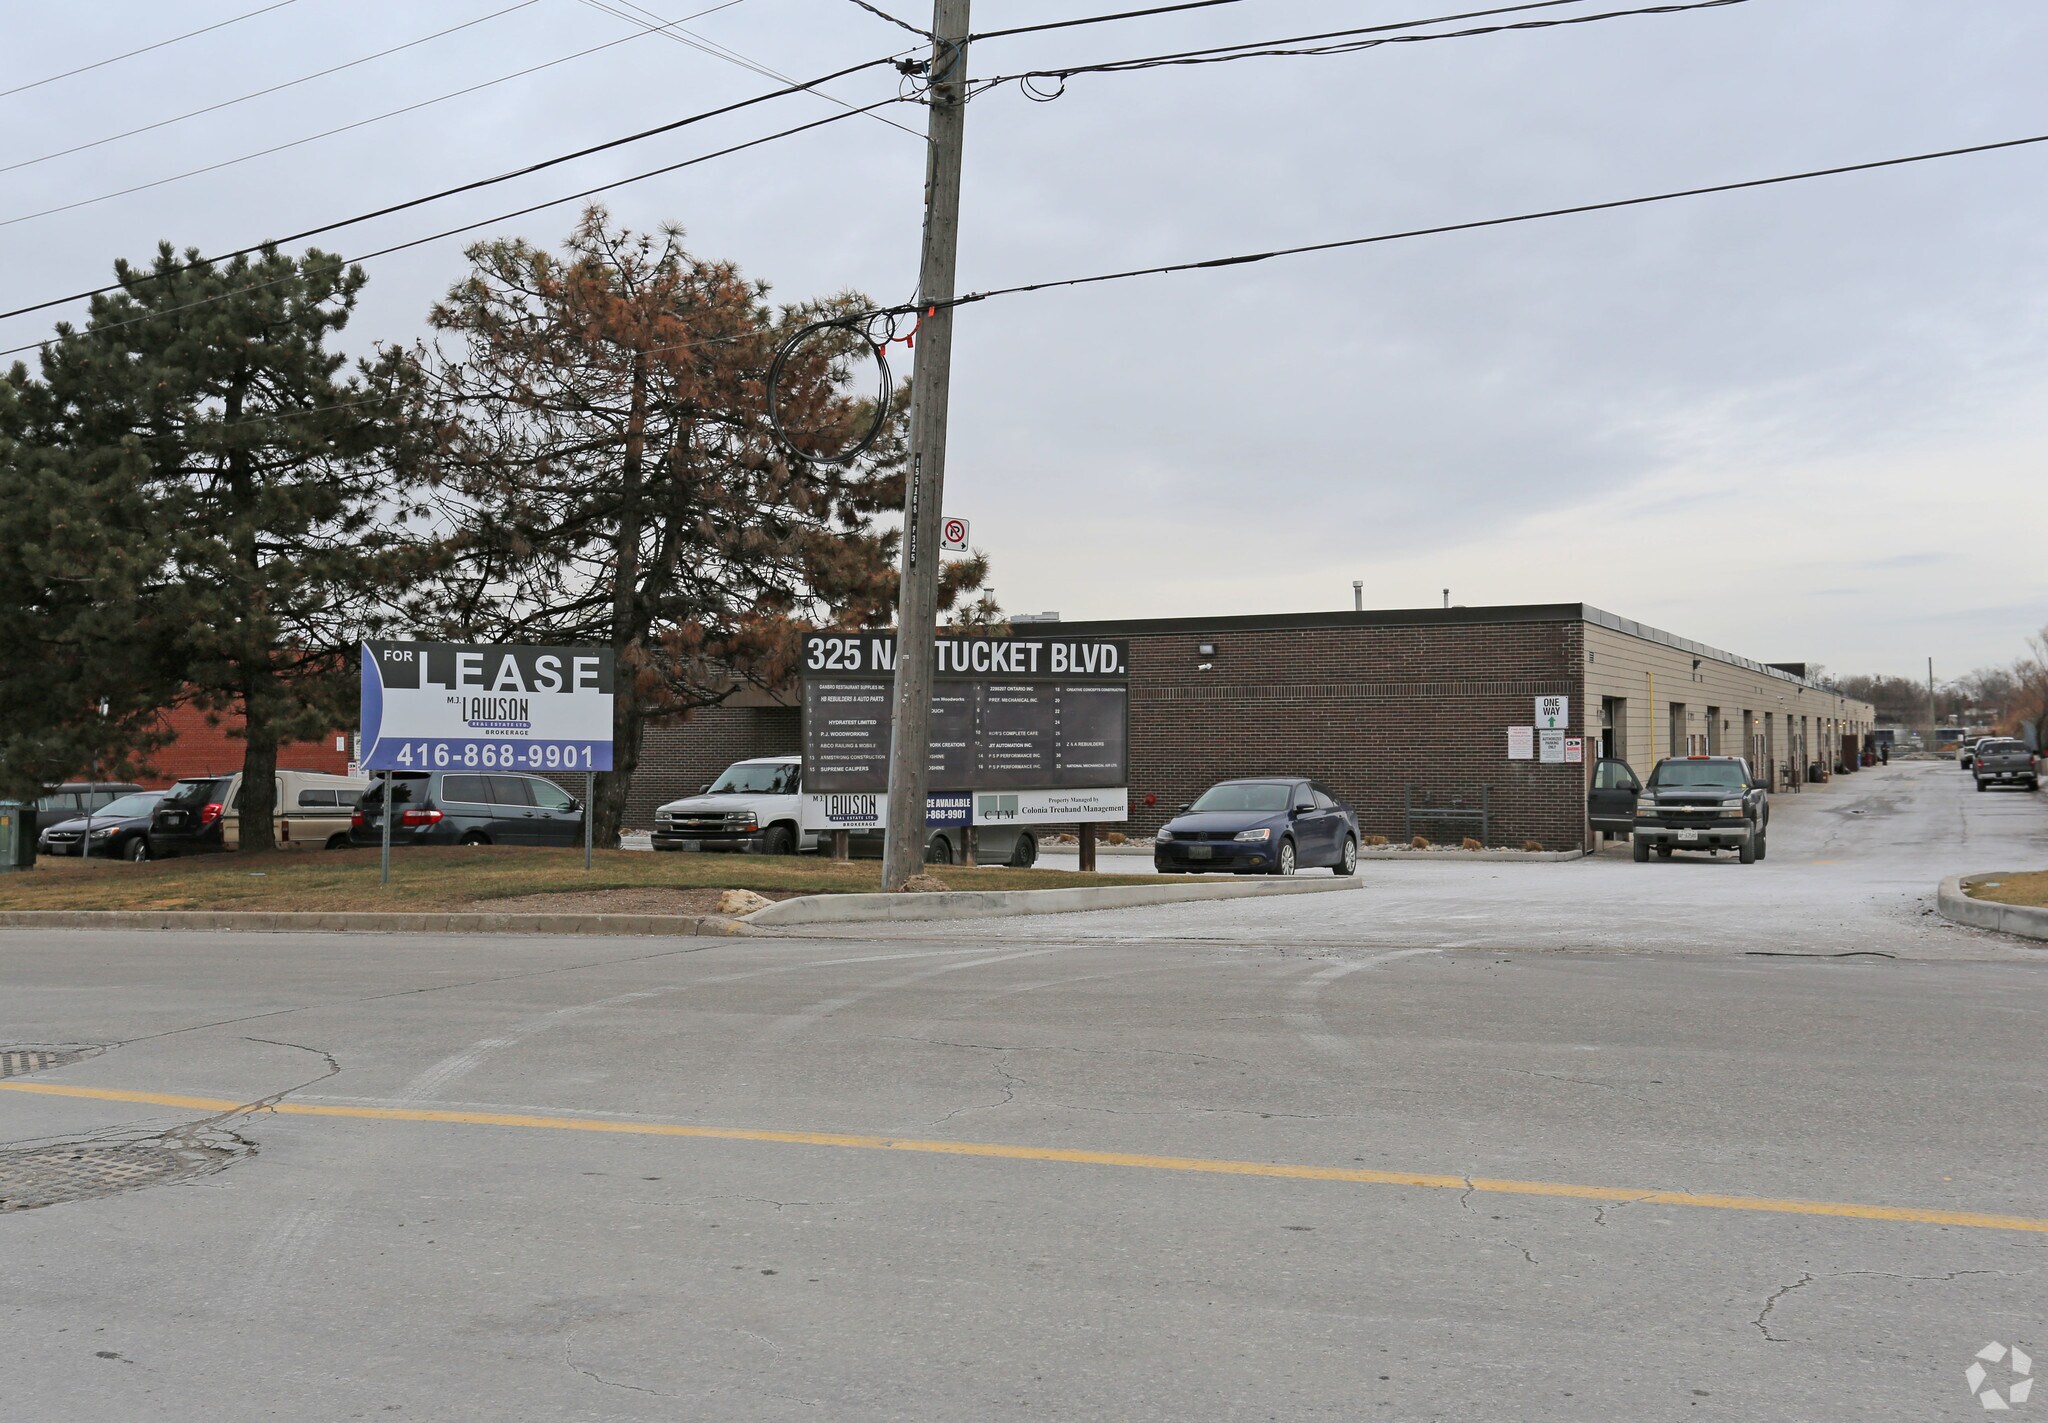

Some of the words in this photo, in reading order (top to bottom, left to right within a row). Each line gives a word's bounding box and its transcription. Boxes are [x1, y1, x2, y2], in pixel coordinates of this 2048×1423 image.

[807, 638, 861, 670] 325
[872, 639, 1042, 672] NTUCKET
[1051, 643, 1125, 674] BLVD.
[384, 650, 413, 661] FOR
[419, 651, 599, 694] LEASE
[462, 697, 528, 722] LAWSON
[1543, 698, 1560, 707] ONE
[1542, 707, 1561, 716] WAY
[396, 742, 592, 768] 416-868-9901
[825, 795, 876, 817] LAWSON
[935, 798, 971, 808] AVAILABLE
[1021, 806, 1048, 814] Colonia
[1049, 805, 1081, 814] Treuhand
[1083, 805, 1124, 813] Management
[926, 809, 966, 819] -868-9901
